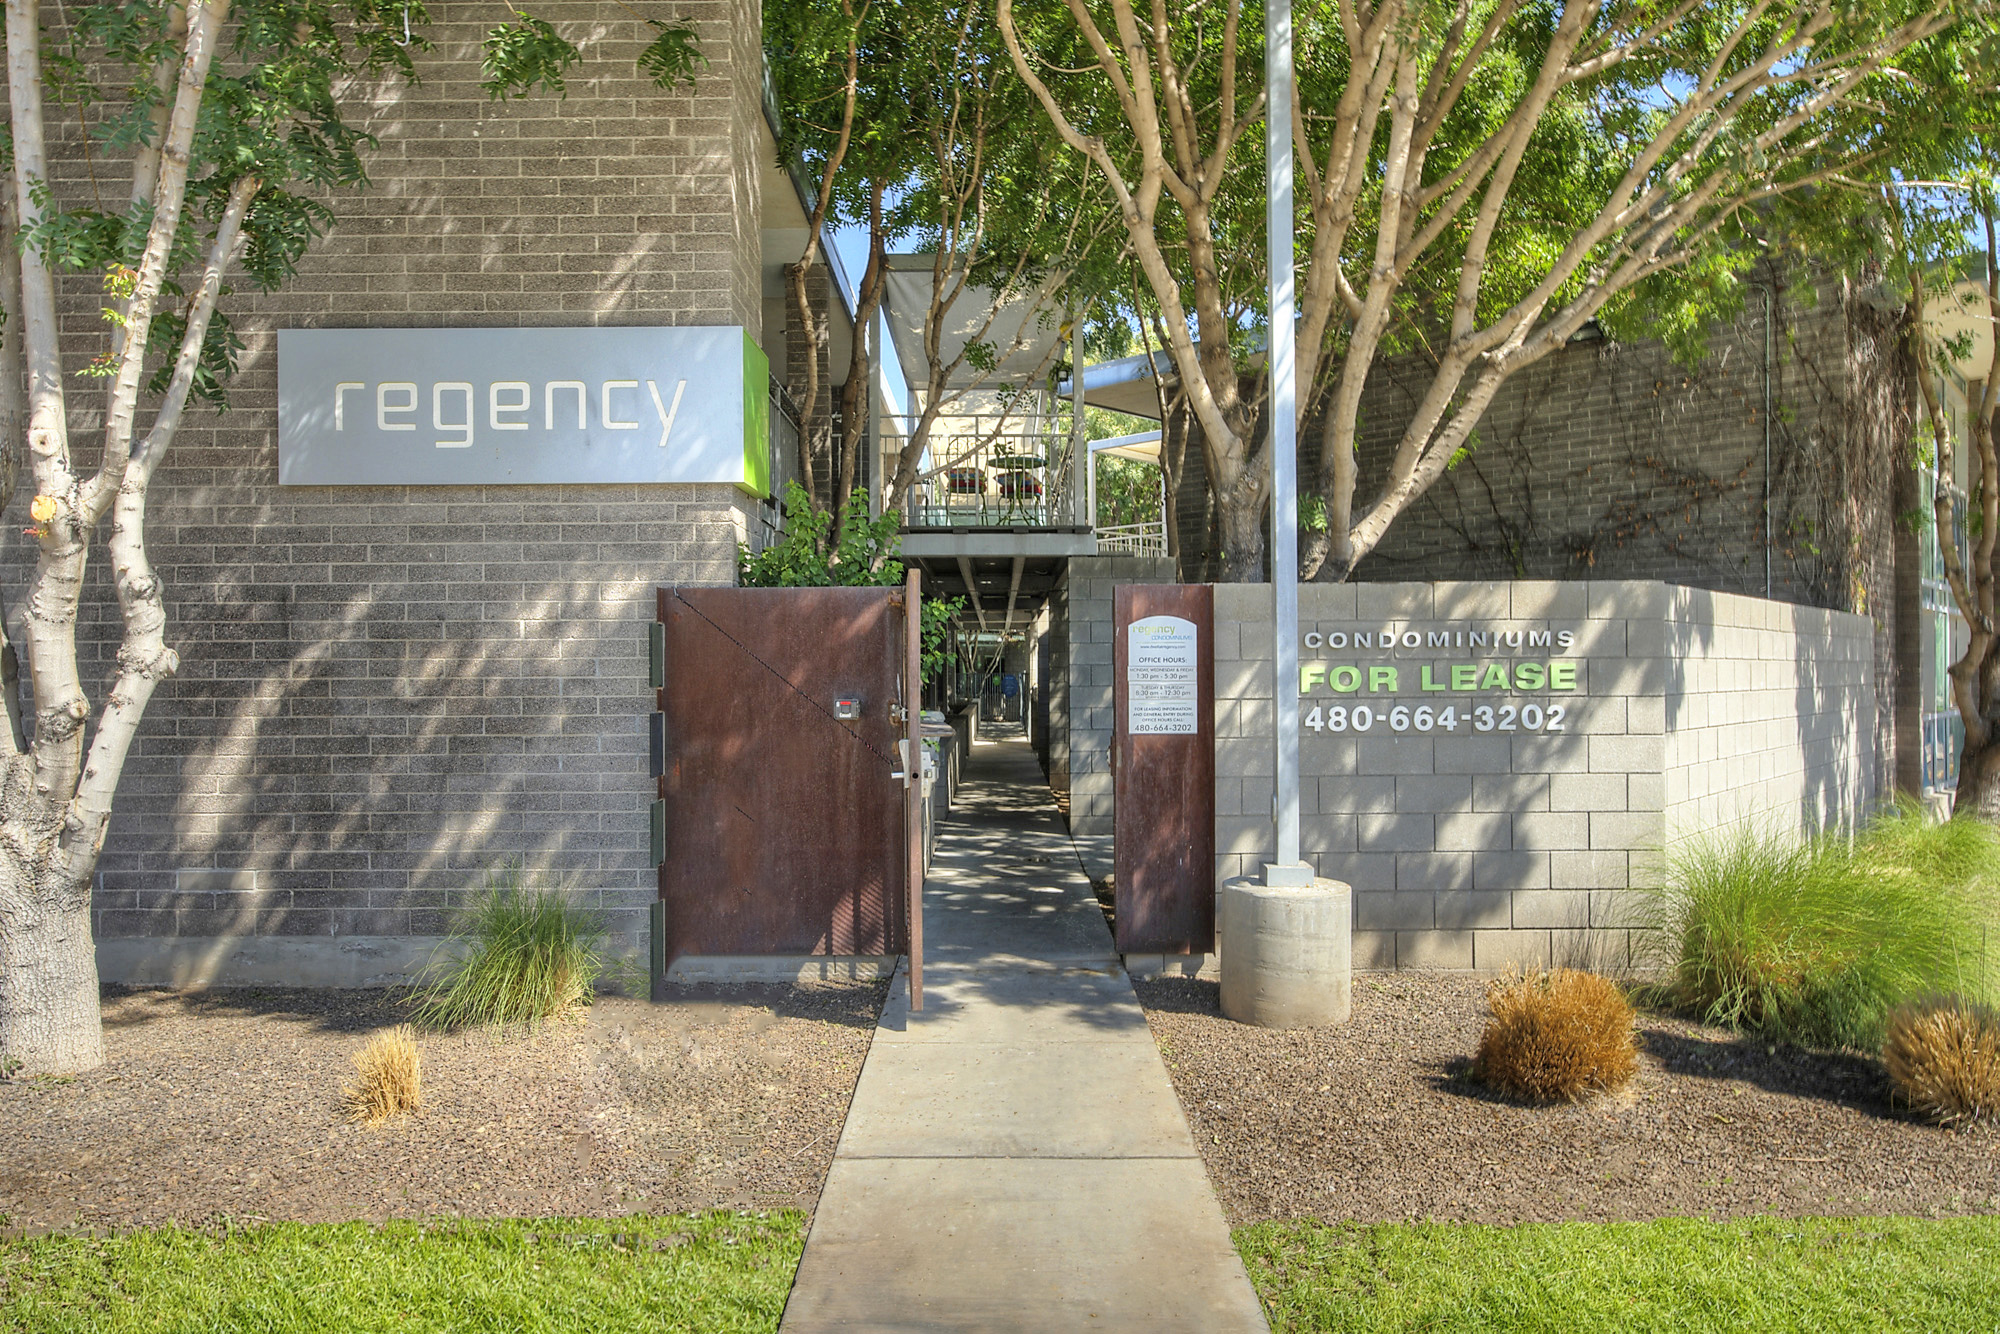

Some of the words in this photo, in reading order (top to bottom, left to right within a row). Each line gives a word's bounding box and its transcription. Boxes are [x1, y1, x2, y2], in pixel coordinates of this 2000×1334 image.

[334, 380, 687, 449] regency
[1132, 625, 1176, 635] regency
[1304, 630, 1576, 649] CONDOMINIUMS
[1138, 656, 1162, 664] OFFICE
[1299, 664, 1399, 693] FOR
[1421, 662, 1577, 692] LEASE
[1134, 724, 1192, 732] 480-664-3202
[1304, 705, 1566, 732] 480-664-3202
